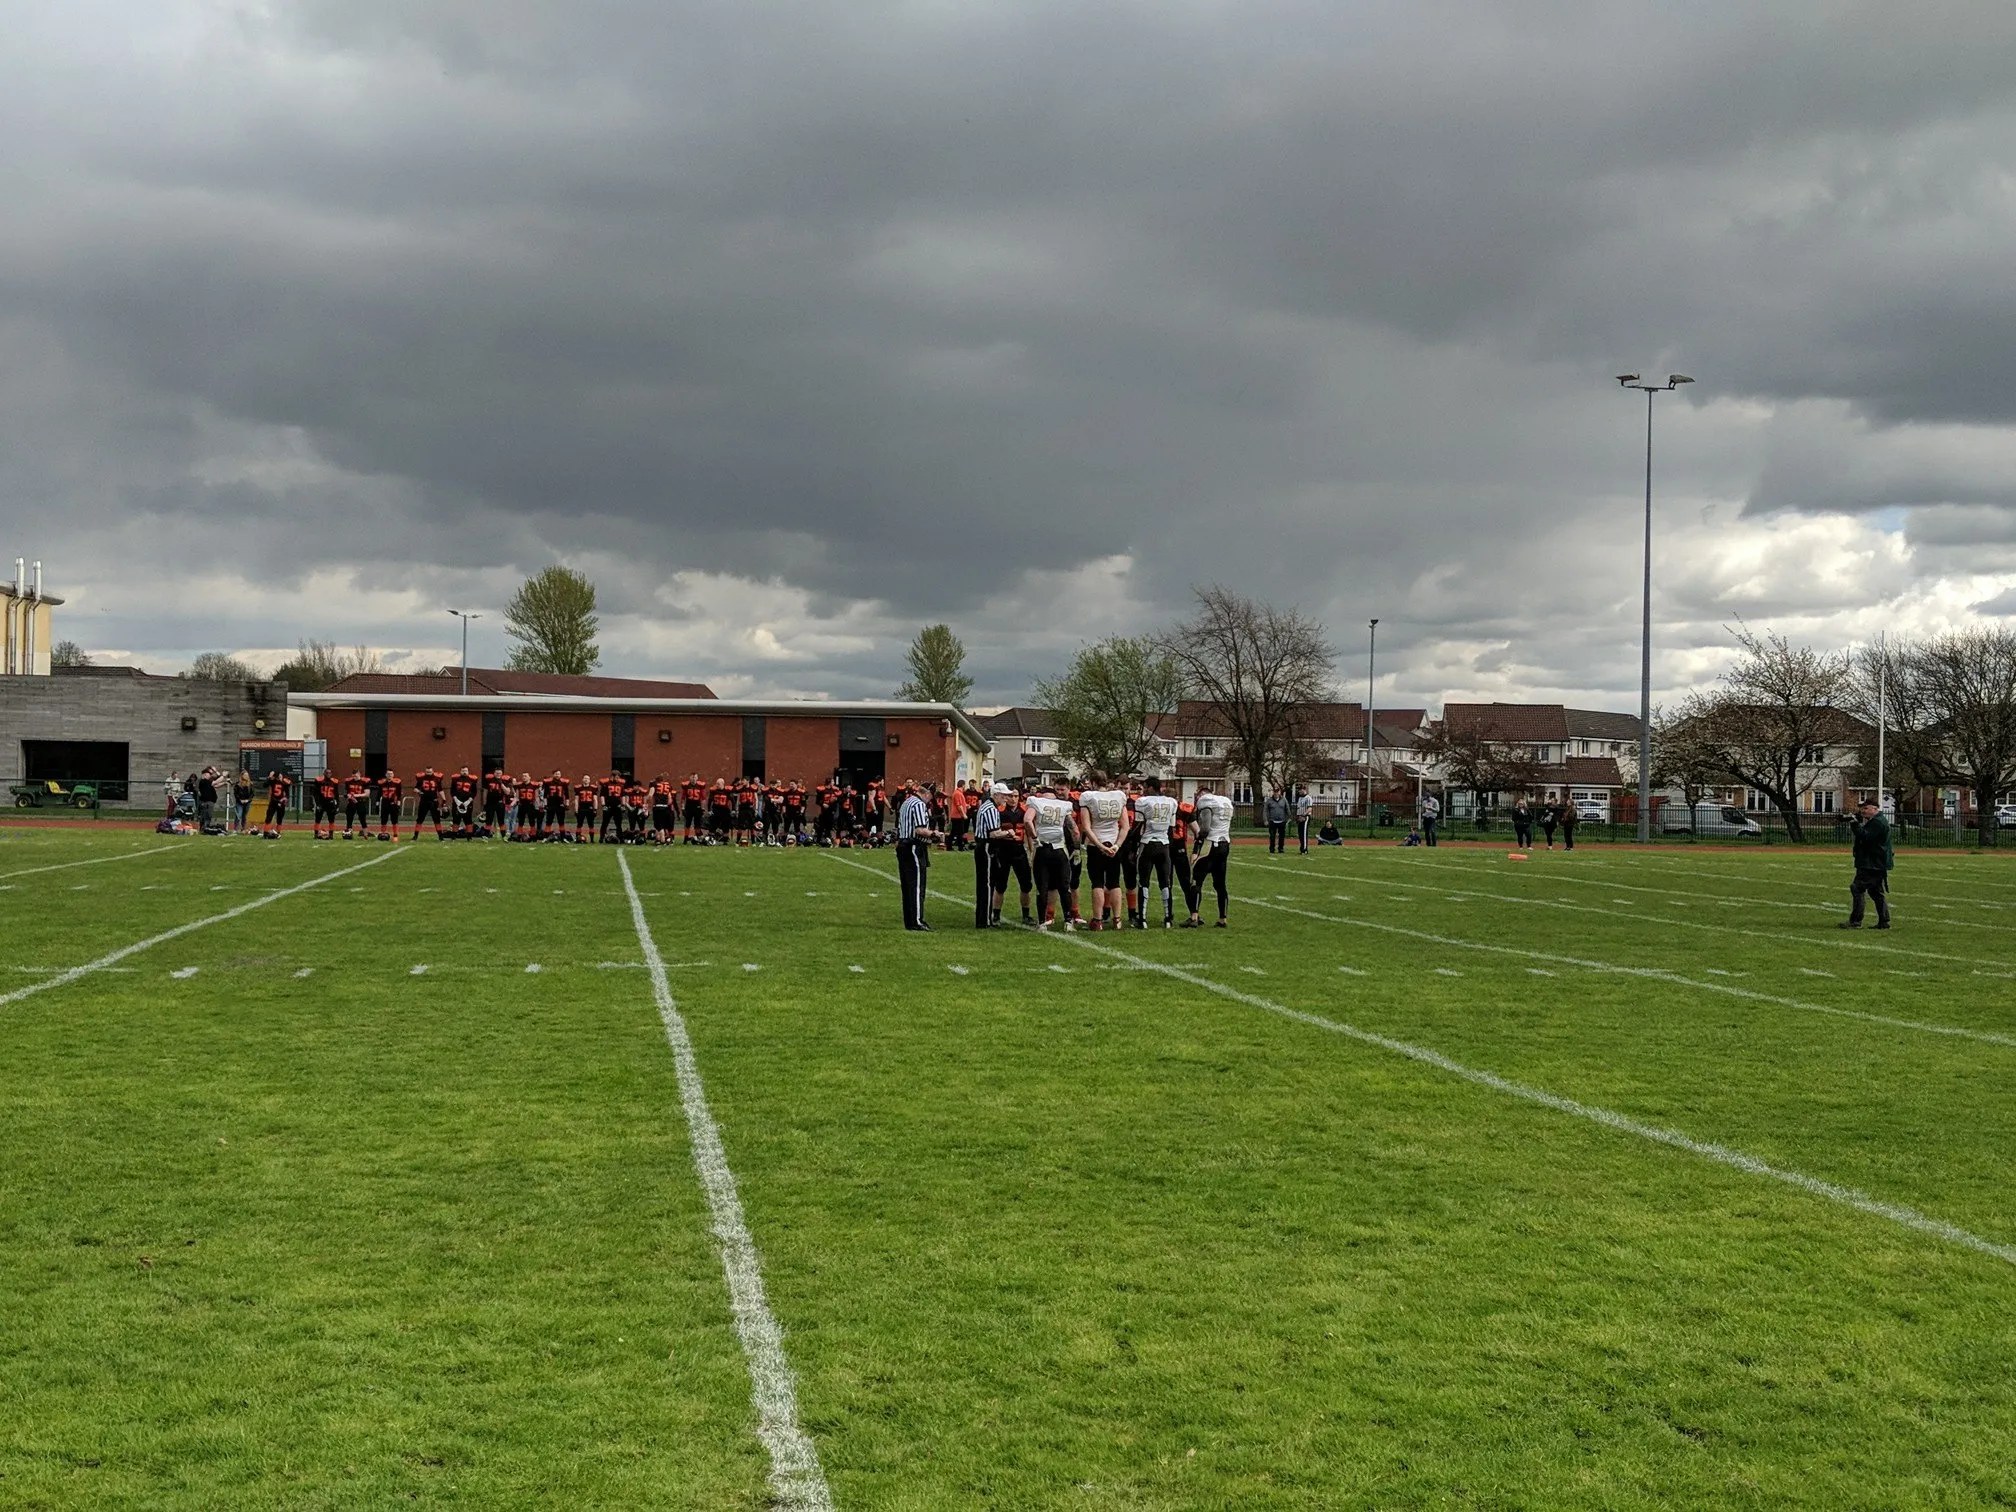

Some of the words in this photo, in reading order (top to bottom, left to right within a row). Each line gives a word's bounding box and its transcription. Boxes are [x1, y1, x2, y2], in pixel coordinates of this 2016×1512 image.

[273, 783, 282, 796] 5
[321, 786, 334, 798] 46
[580, 790, 593, 802] 32
[657, 783, 670, 796] 35
[1041, 806, 1062, 825] 21
[1098, 800, 1121, 820] 52
[1153, 803, 1170, 822] 17
